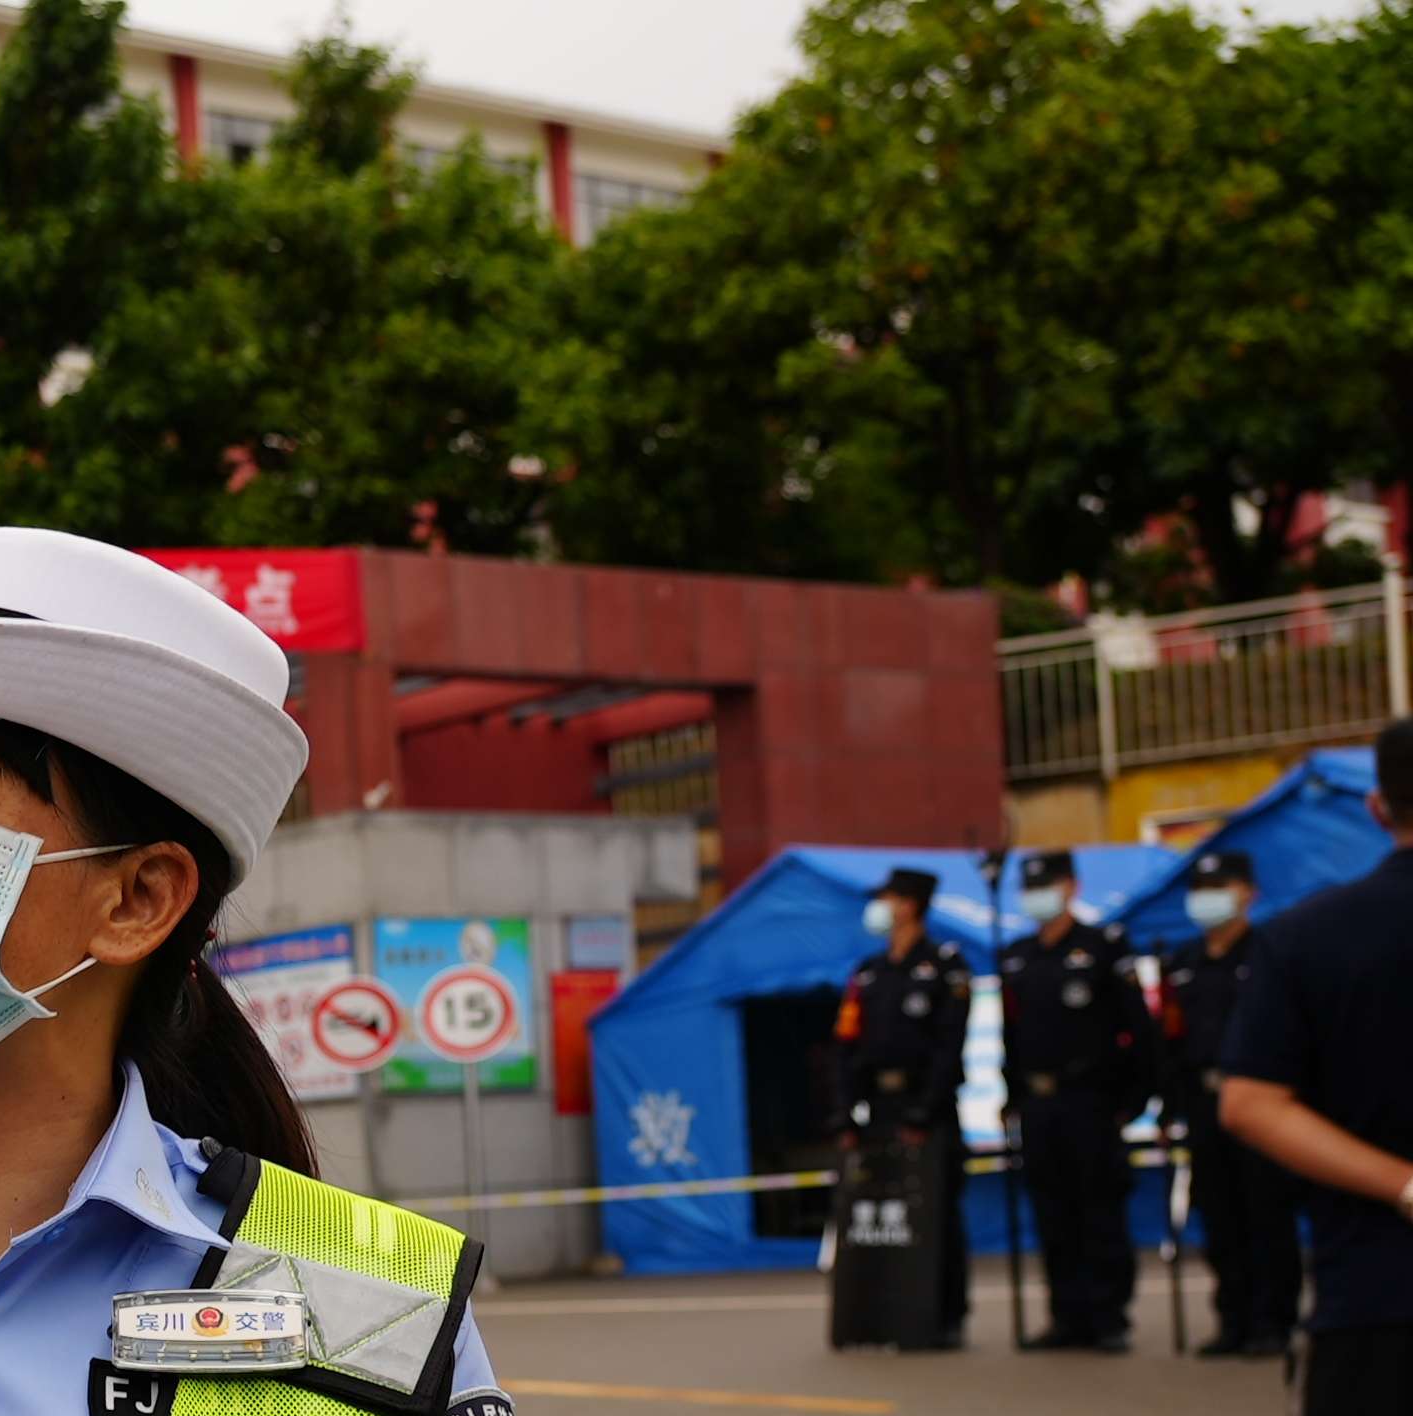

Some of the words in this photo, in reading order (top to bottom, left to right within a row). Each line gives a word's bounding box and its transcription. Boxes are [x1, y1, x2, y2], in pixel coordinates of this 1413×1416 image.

[443, 990, 495, 1030] 15
[135, 1311, 185, 1333] 宾川
[235, 1310, 286, 1333] 交警
